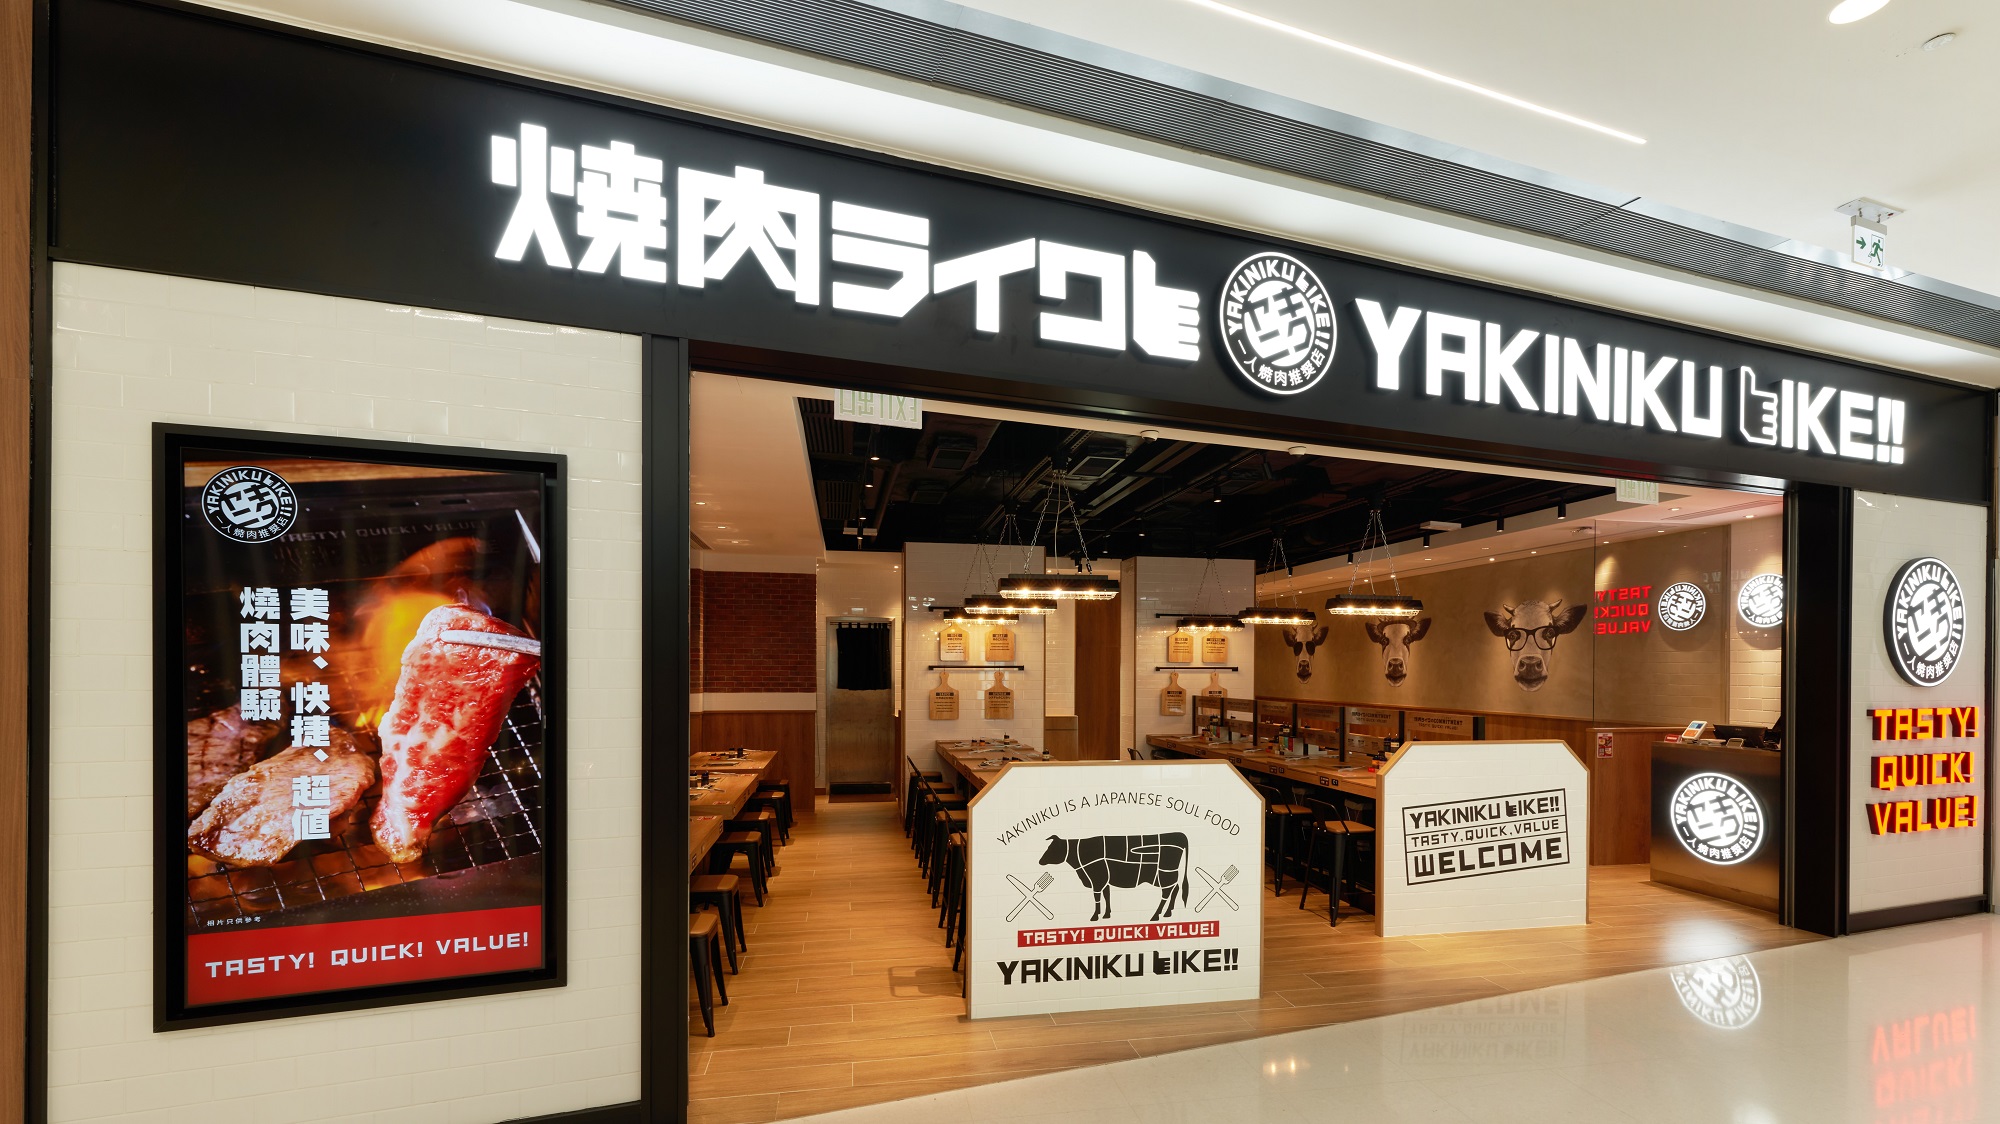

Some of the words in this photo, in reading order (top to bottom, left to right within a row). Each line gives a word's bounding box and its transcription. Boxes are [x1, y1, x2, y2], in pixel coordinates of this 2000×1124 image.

[1227, 260, 1295, 335] YAKINIKU
[1355, 298, 1722, 438] YAKINIKU
[207, 470, 263, 514] YAKINIKU
[1897, 564, 1941, 640] YAKINIKU
[239, 585, 282, 721] 燒肉體驗
[1873, 706, 1979, 740] TASTY!
[1879, 752, 1974, 791] QUICK!
[997, 804, 1061, 846] YAKINIKU
[1064, 799, 1077, 813] IS
[1080, 796, 1091, 808] A
[1094, 791, 1163, 806] JAPANESE
[1166, 796, 1200, 818] SOUL
[1203, 809, 1241, 836] FOOD
[1409, 802, 1501, 829] YAKINIKU
[1675, 777, 1728, 825] YAKINIKU
[1873, 795, 1979, 835] VALUE!
[1414, 837, 1563, 878] WELCOME
[205, 952, 315, 978] TASTY!
[331, 941, 423, 966] QUICK!
[436, 931, 529, 955] VALUE!
[1023, 929, 1086, 944] TASTY!
[1093, 926, 1149, 942] QUICK!
[1156, 923, 1215, 938] VALUE!
[996, 952, 1145, 985] YAKINIKU
